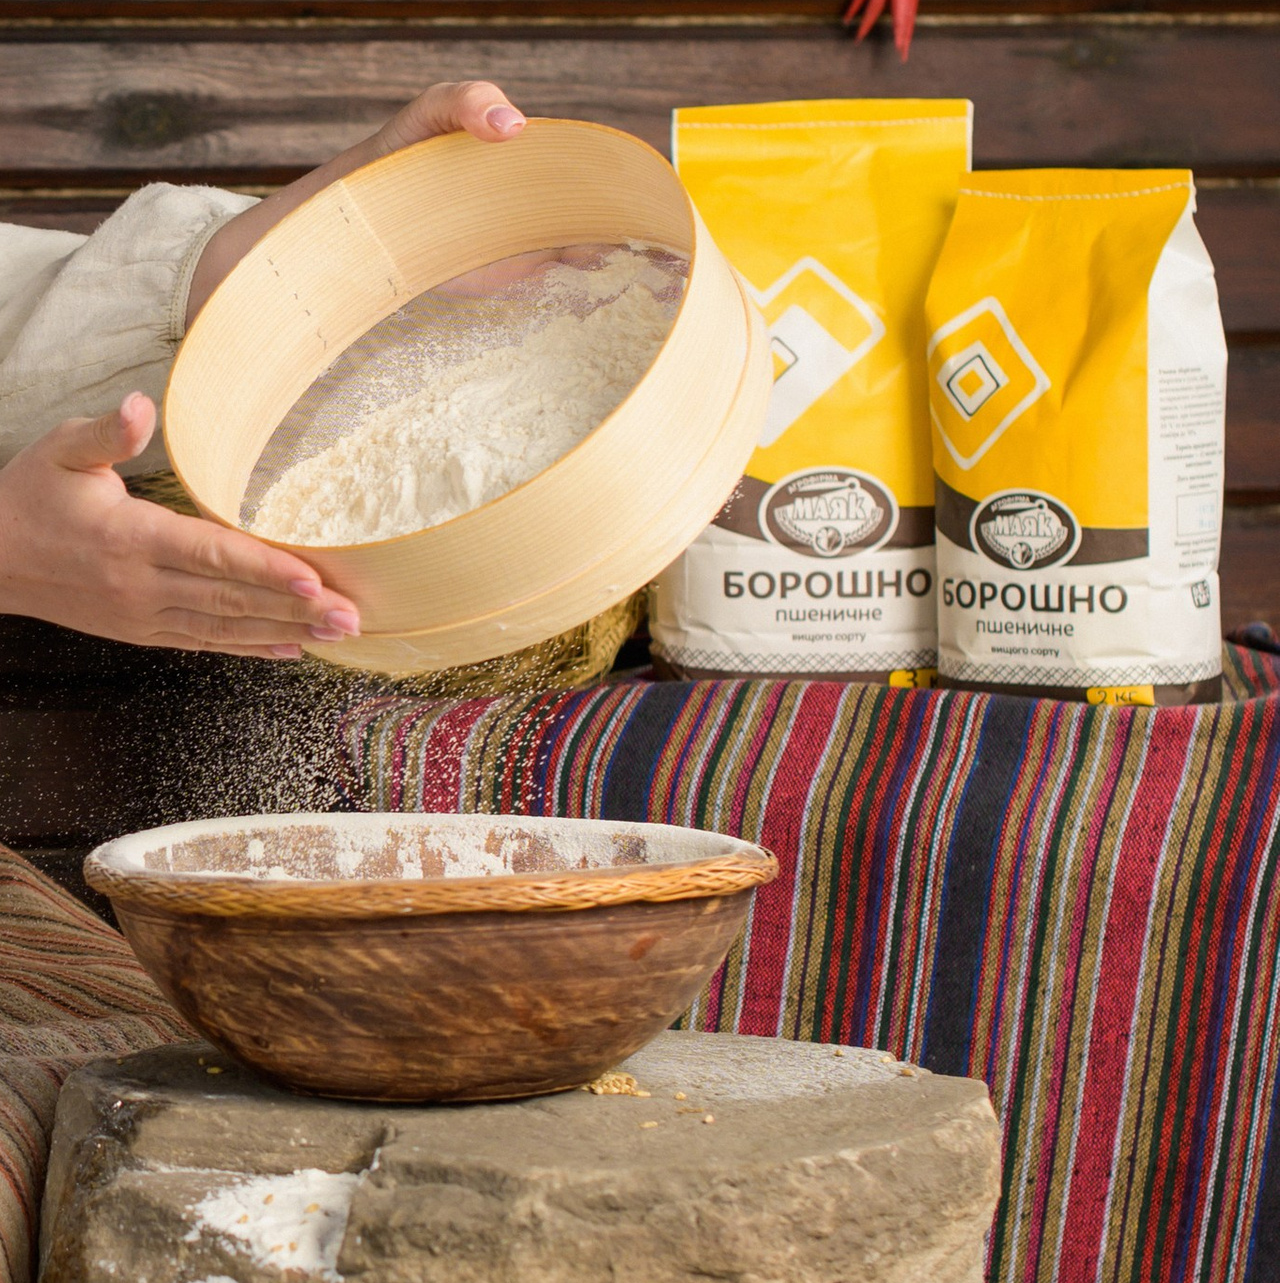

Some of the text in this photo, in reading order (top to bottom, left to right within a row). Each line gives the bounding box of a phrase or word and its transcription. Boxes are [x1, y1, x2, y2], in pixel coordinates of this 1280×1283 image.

[795, 492, 868, 521] МАЯК
[993, 512, 1054, 537] МАЯК
[723, 568, 932, 599] БОРОШНО
[942, 578, 1128, 614] БОРОШНО
[775, 607, 883, 622] пшеничне
[976, 620, 1075, 637] пшеничне
[792, 632, 866, 643] вищого сорту
[991, 645, 1060, 658] вищого сорту
[1097, 690, 1138, 705] 2 кг
